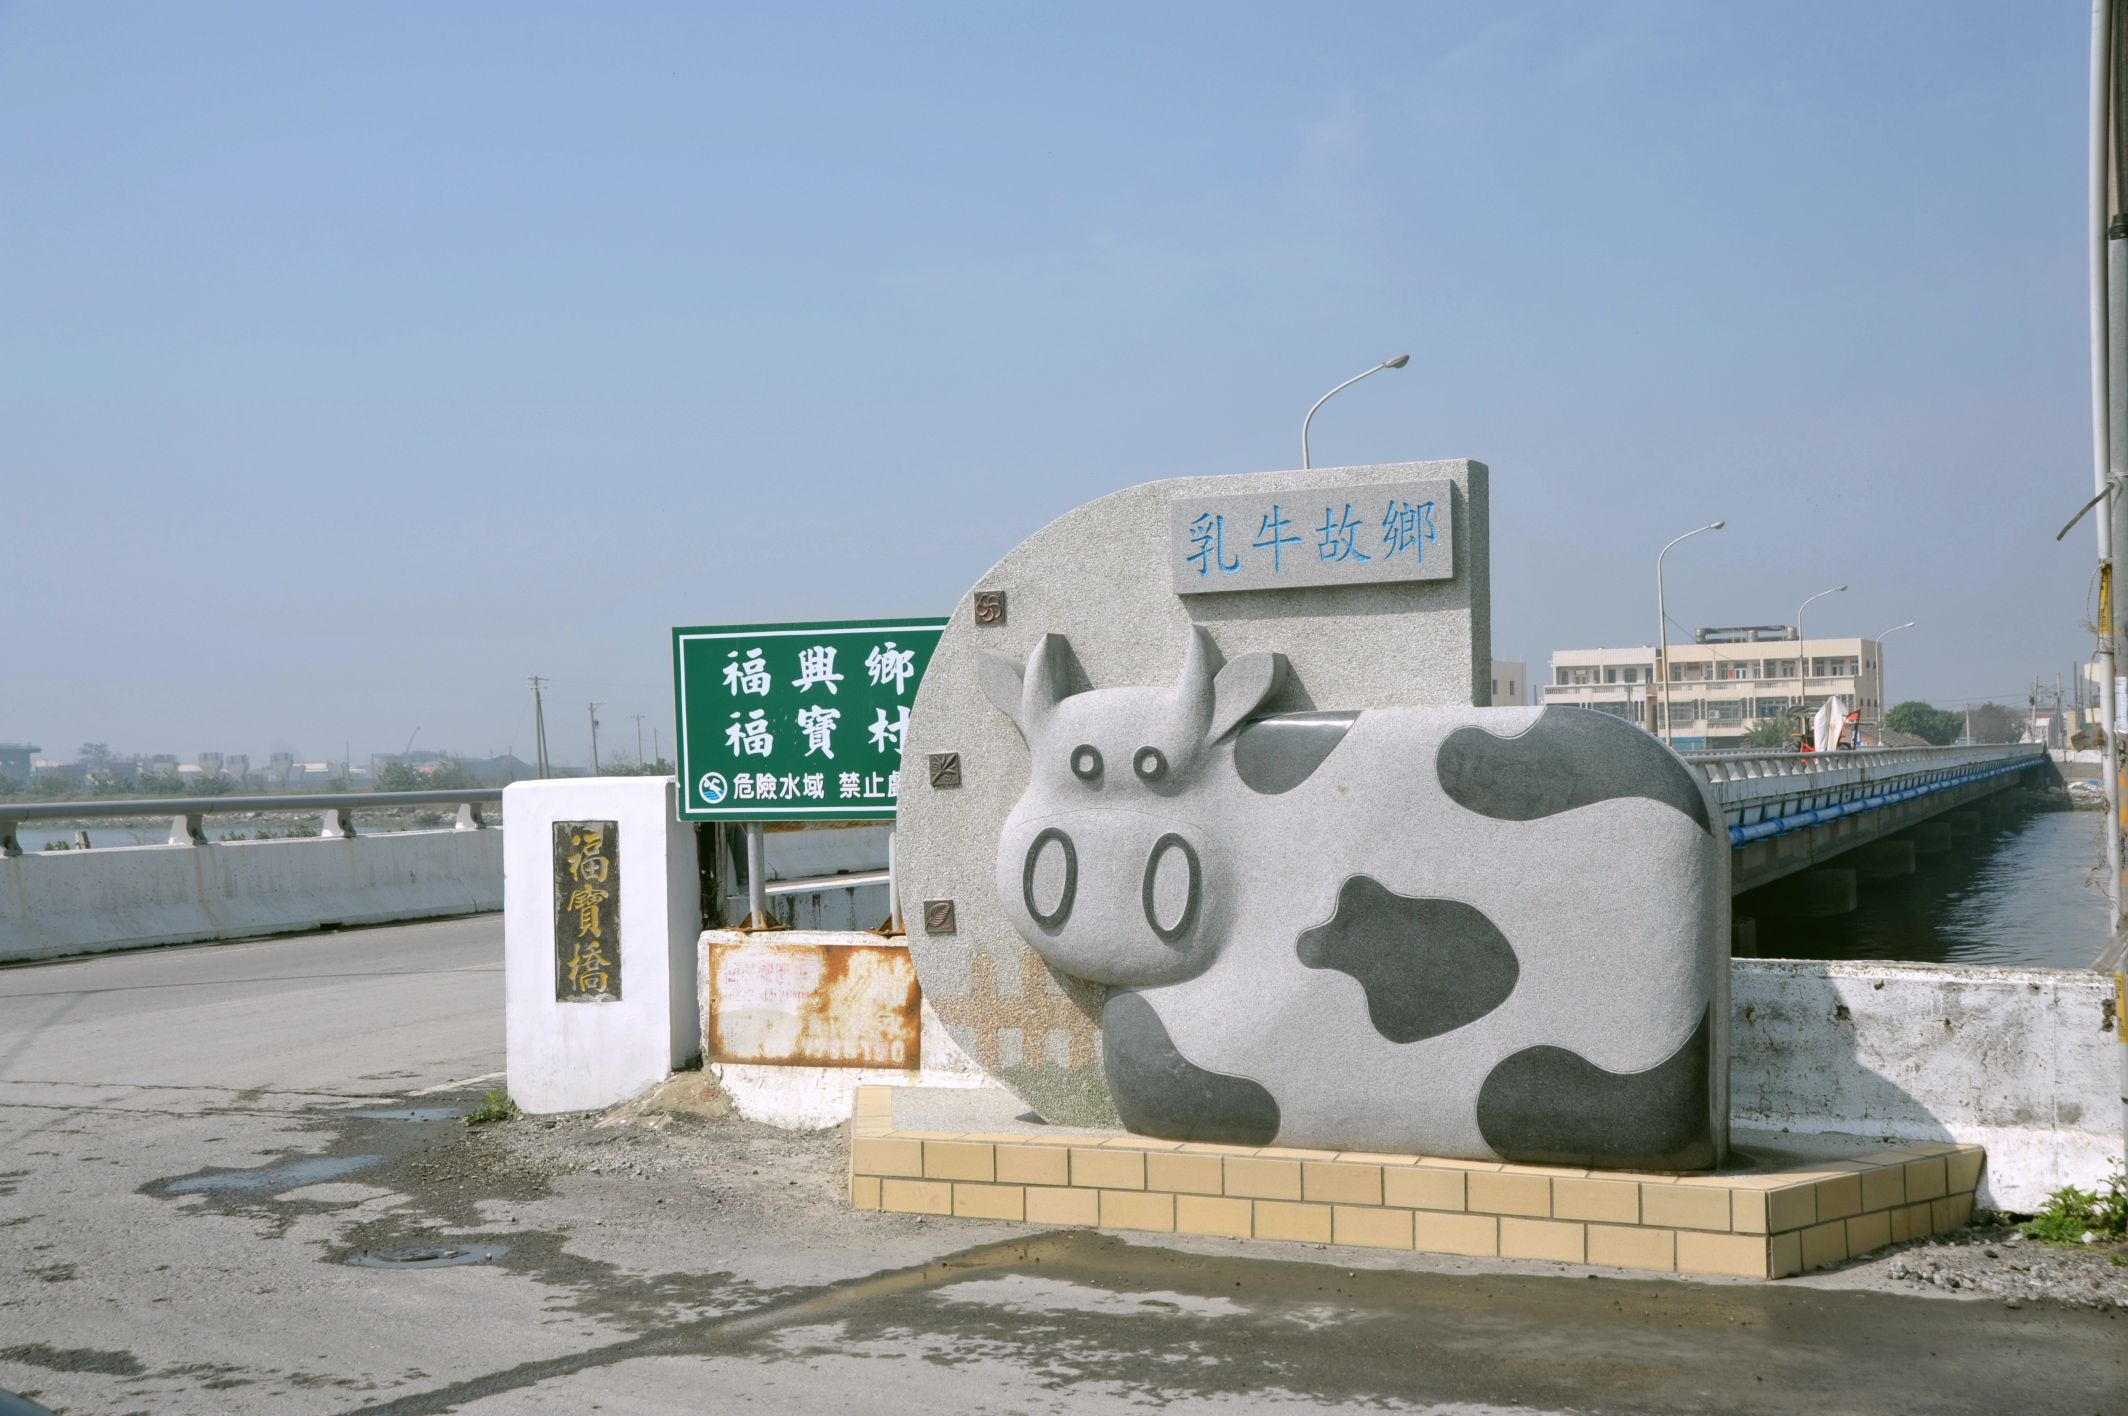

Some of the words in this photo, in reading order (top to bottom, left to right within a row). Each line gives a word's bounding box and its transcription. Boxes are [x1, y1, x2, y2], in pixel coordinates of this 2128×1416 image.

[1186, 499, 1438, 577] 乳牛故鄉
[722, 641, 915, 696] 福興鄉
[725, 705, 911, 758] 福寶村
[733, 772, 825, 800] 危險水域
[567, 831, 611, 993] 福寶橋
